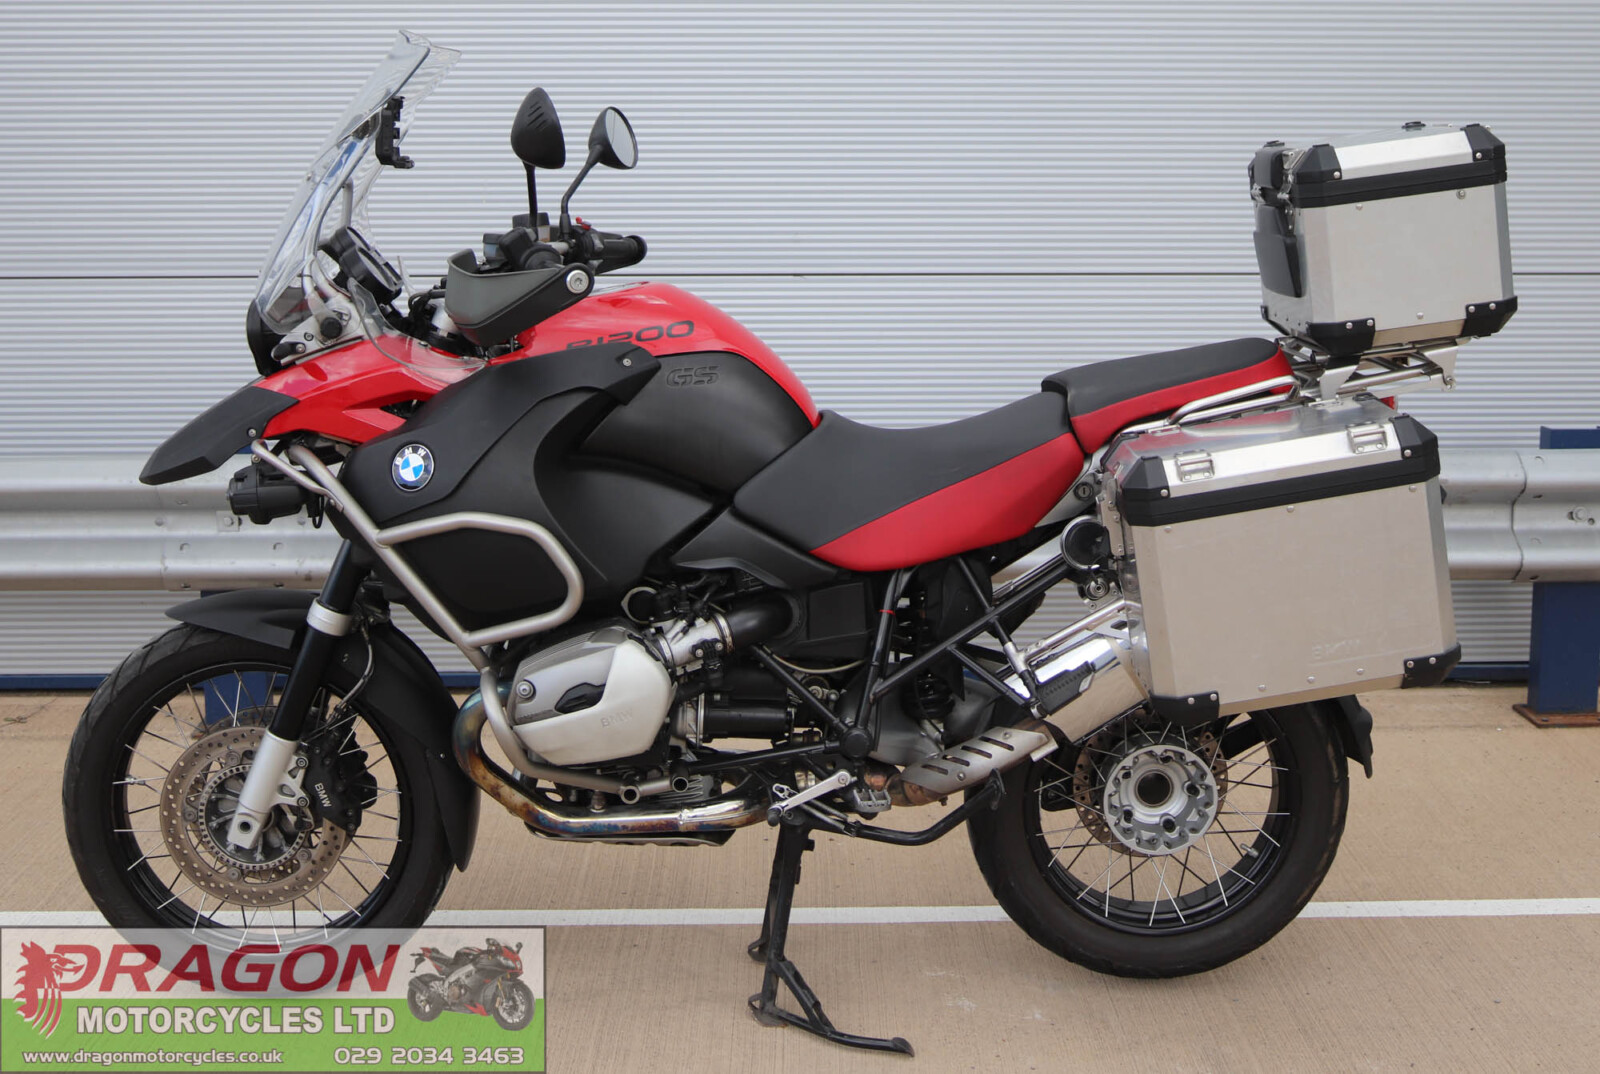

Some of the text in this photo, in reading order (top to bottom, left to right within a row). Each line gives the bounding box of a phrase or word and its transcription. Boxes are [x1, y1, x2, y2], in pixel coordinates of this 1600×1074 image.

[667, 366, 719, 387] GS
[394, 446, 427, 465] BMW
[314, 783, 332, 807] BMW
